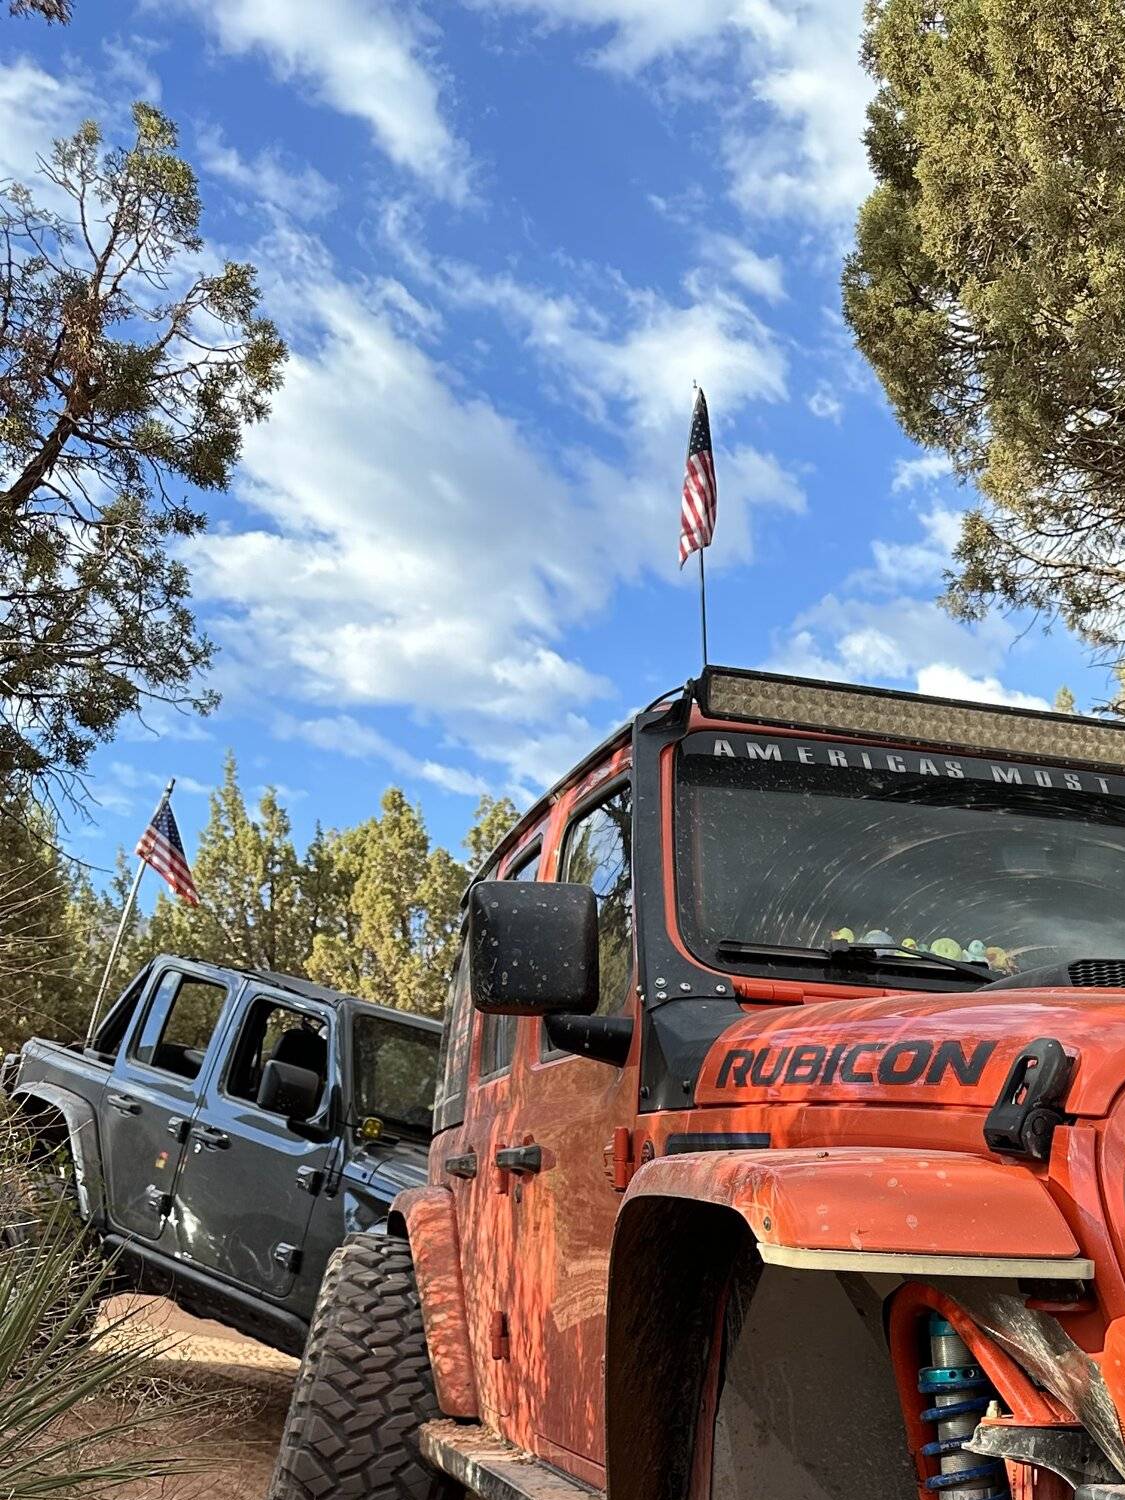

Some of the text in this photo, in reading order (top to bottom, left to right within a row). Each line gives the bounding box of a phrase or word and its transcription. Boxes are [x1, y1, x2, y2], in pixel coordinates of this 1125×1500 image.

[712, 739, 965, 779] AMERICAS
[990, 765, 1114, 794] MOST
[714, 1039, 1000, 1089] RUBICON
